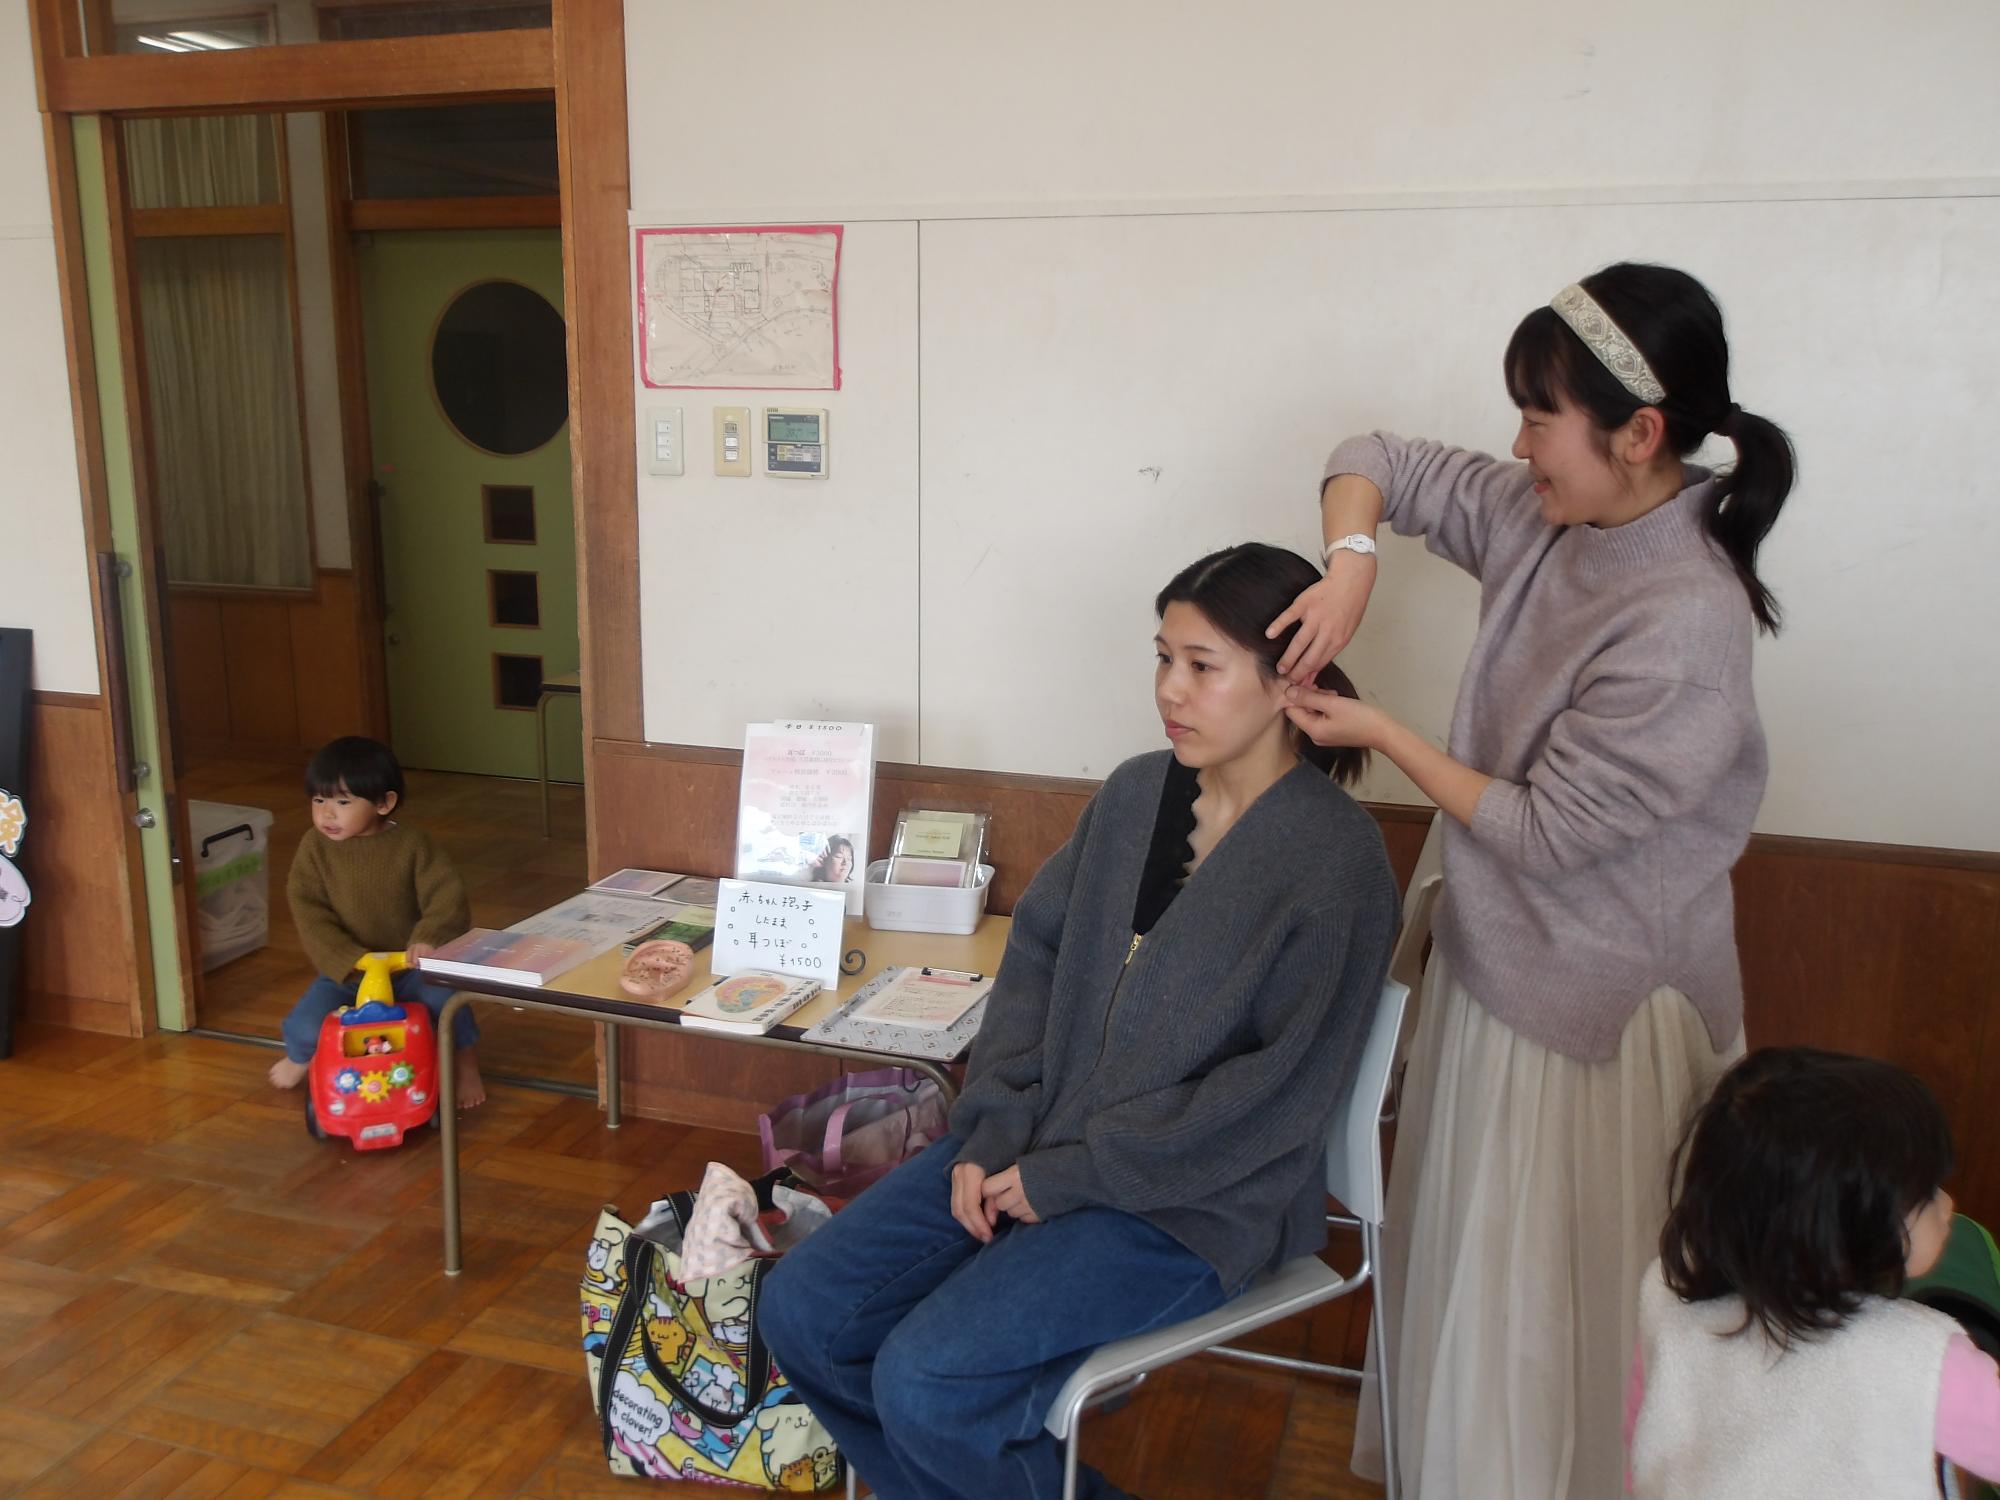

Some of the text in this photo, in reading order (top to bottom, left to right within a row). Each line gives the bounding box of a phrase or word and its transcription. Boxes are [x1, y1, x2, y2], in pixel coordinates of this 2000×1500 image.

[755, 915, 788, 929] したまま
[748, 931, 793, 949] 耳つぼ
[780, 954, 822, 969] ¥1500
[612, 1389, 663, 1429] decorating
[620, 1411, 653, 1438] clover!
